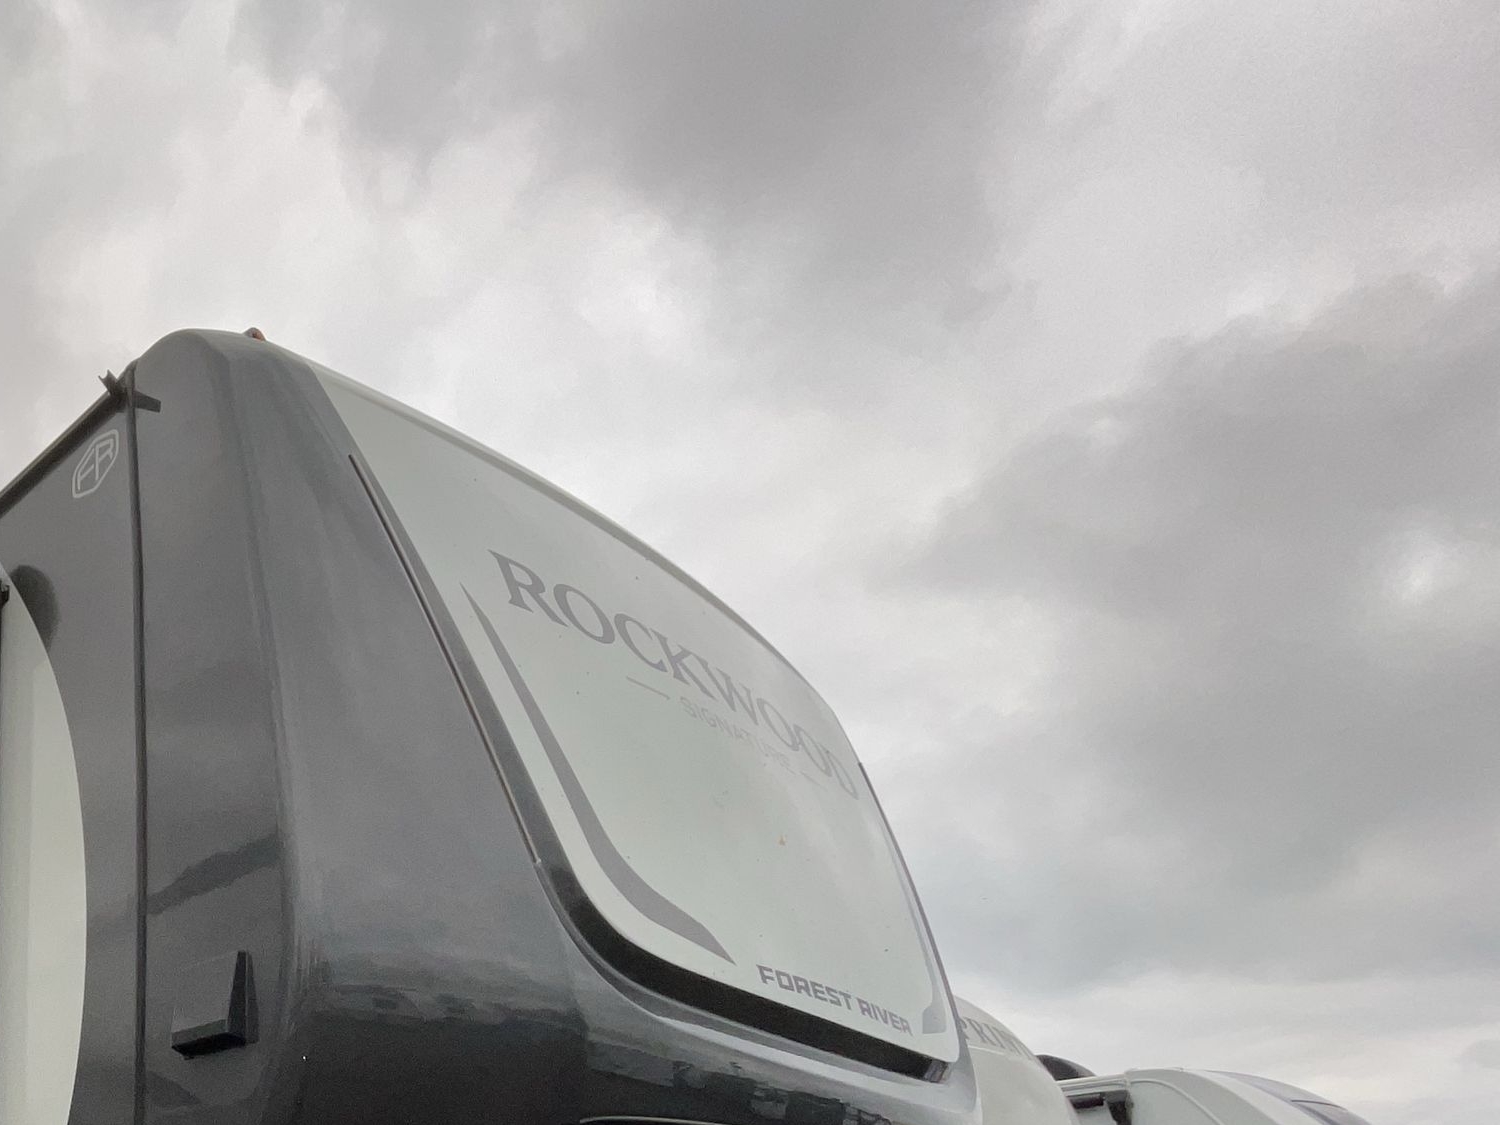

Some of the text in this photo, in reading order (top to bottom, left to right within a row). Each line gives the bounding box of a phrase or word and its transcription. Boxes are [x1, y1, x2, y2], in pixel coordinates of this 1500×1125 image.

[487, 549, 859, 800] ROCKWOOD
[756, 964, 913, 1037] FOREST RIVER
